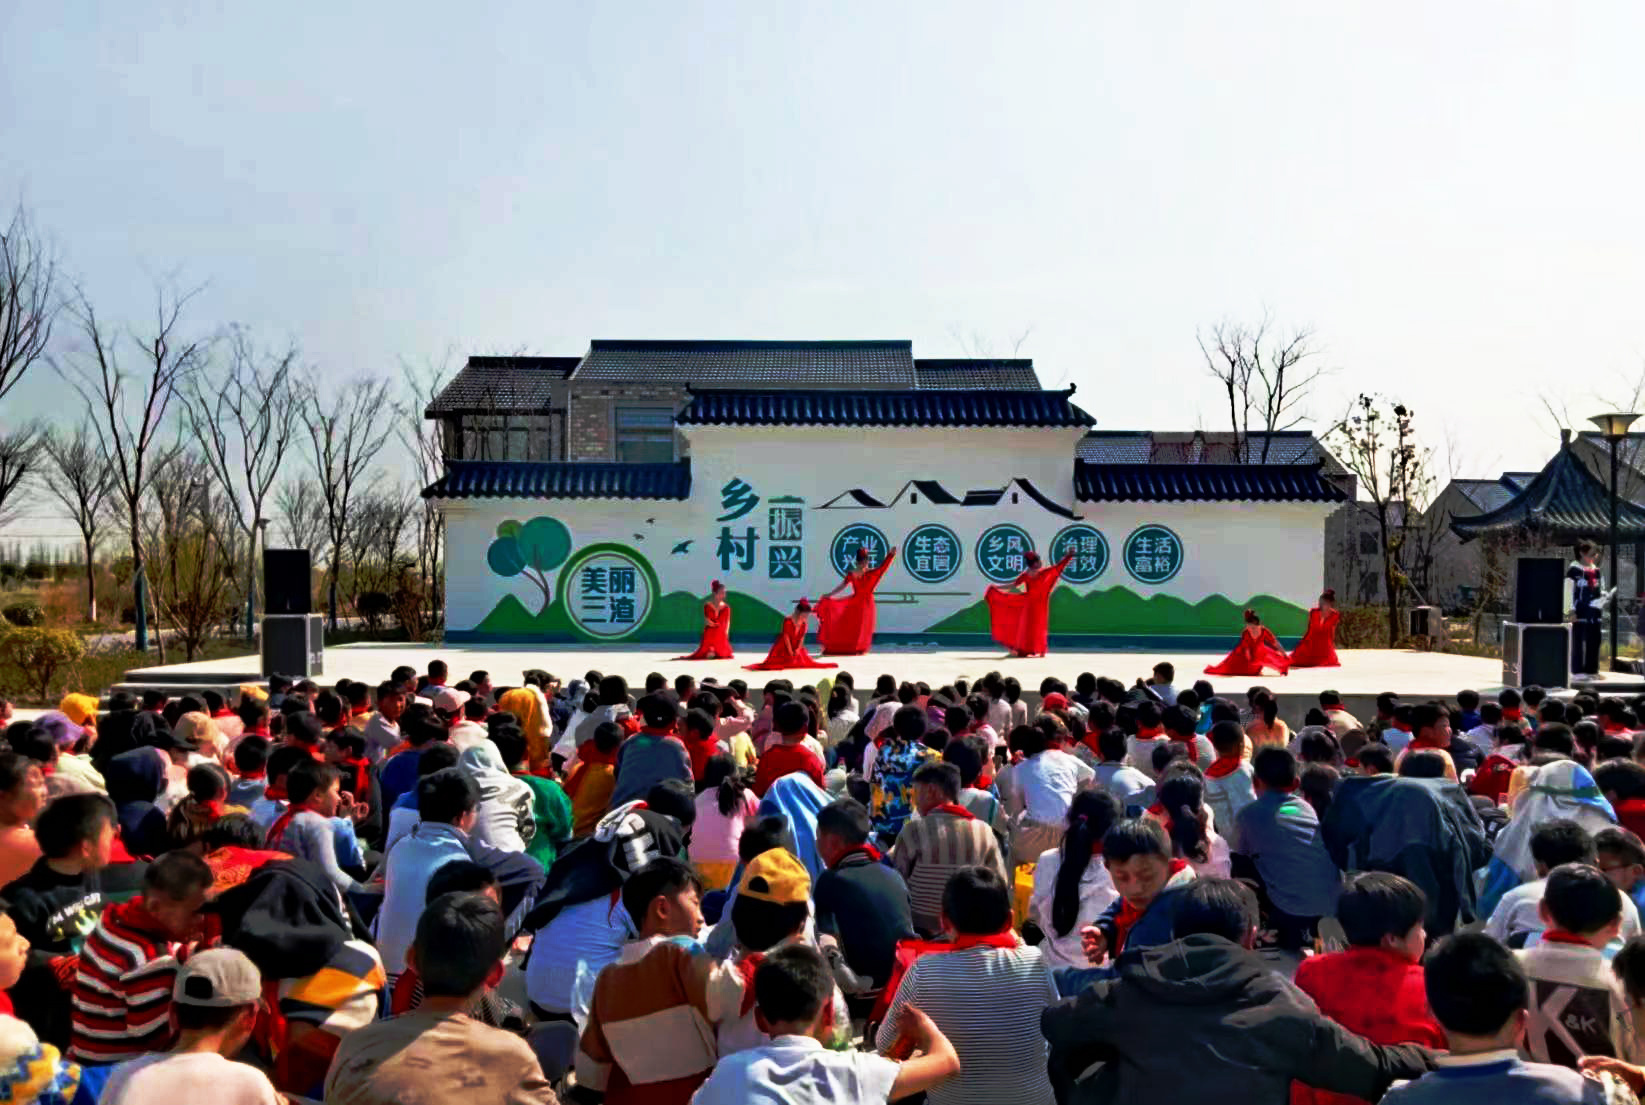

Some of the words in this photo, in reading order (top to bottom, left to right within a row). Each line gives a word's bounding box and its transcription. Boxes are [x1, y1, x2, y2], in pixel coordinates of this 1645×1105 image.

[716, 477, 760, 571] 乡村
[769, 508, 802, 578] 振兴
[914, 535, 950, 553] 生态
[987, 535, 1024, 554] 乡风
[1062, 536, 1098, 554] 治理
[1135, 536, 1172, 554] 生活
[914, 554, 950, 572] 宜居
[987, 554, 1024, 573] 文明
[1135, 555, 1171, 573] 富裕
[581, 566, 636, 594] 美丽
